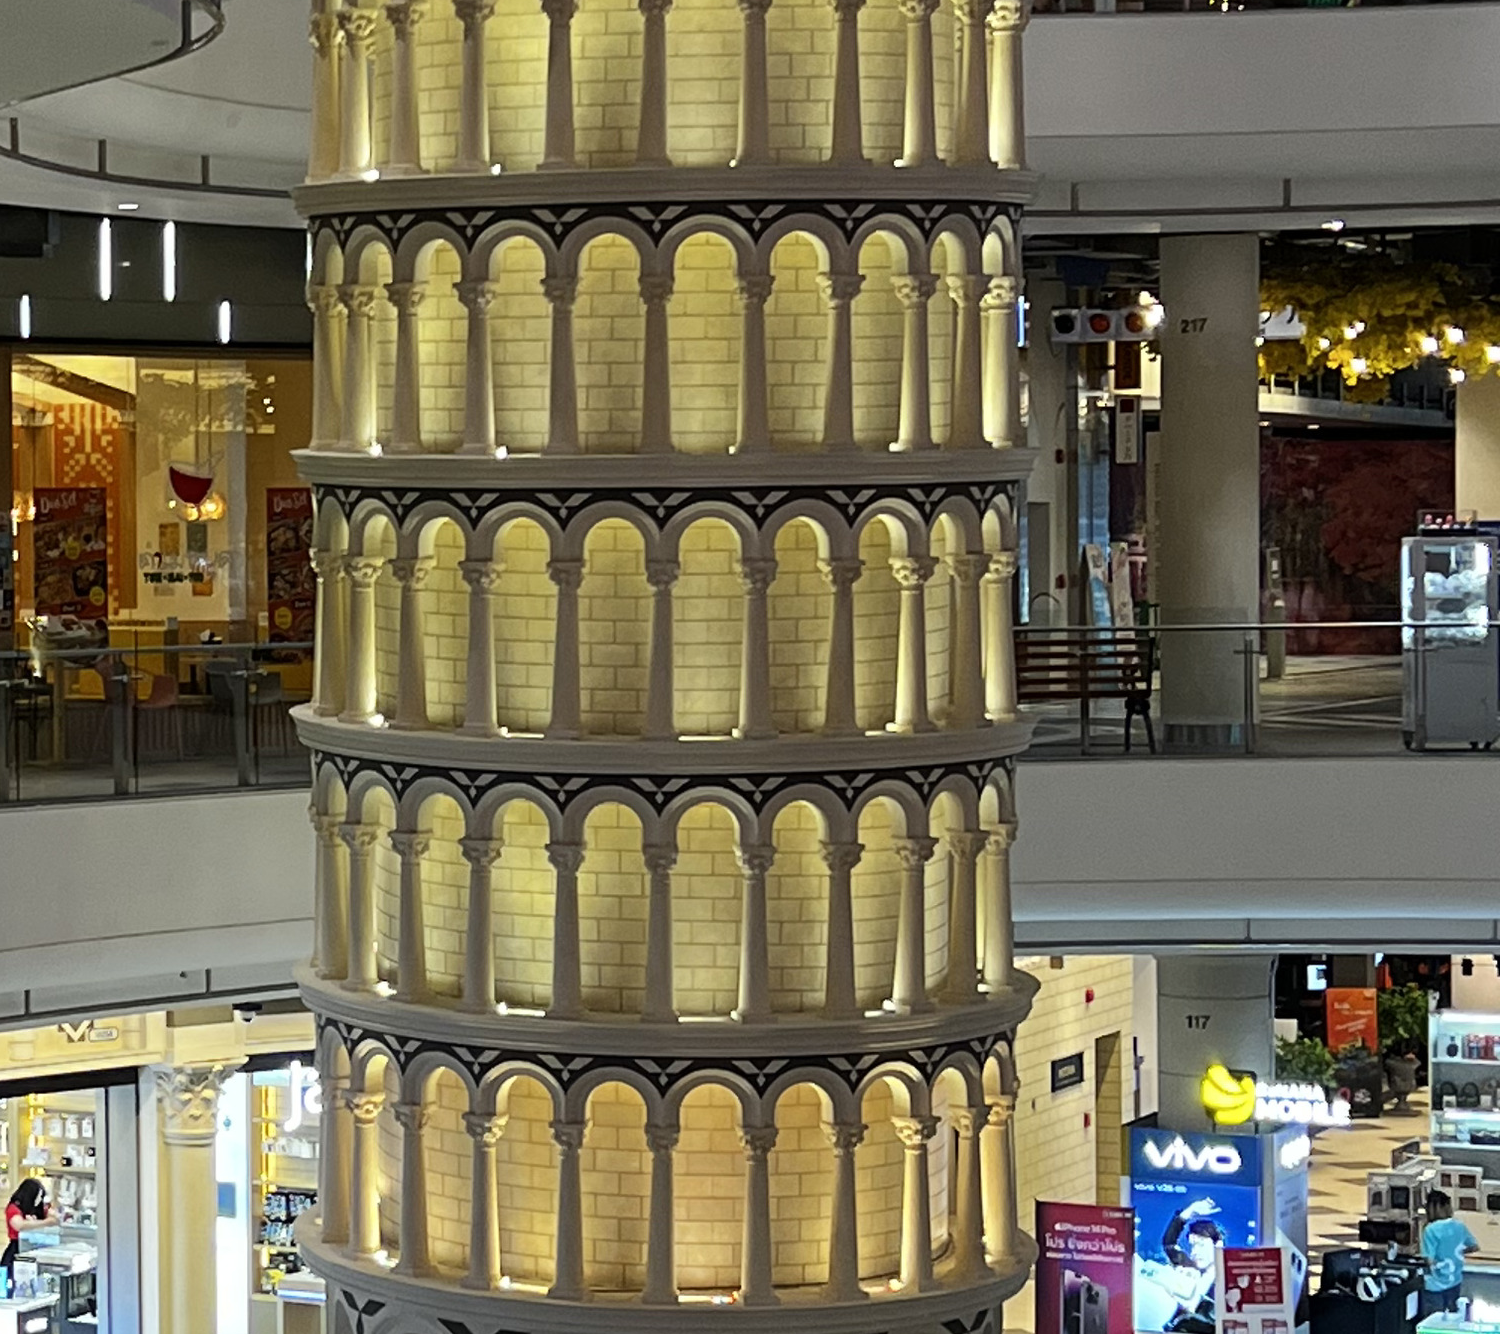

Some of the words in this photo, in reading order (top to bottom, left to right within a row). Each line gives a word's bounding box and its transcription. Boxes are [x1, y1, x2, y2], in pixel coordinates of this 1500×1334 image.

[1180, 317, 1208, 334] 217
[1185, 1014, 1211, 1030] 117
[1143, 1135, 1243, 1174] vivo
